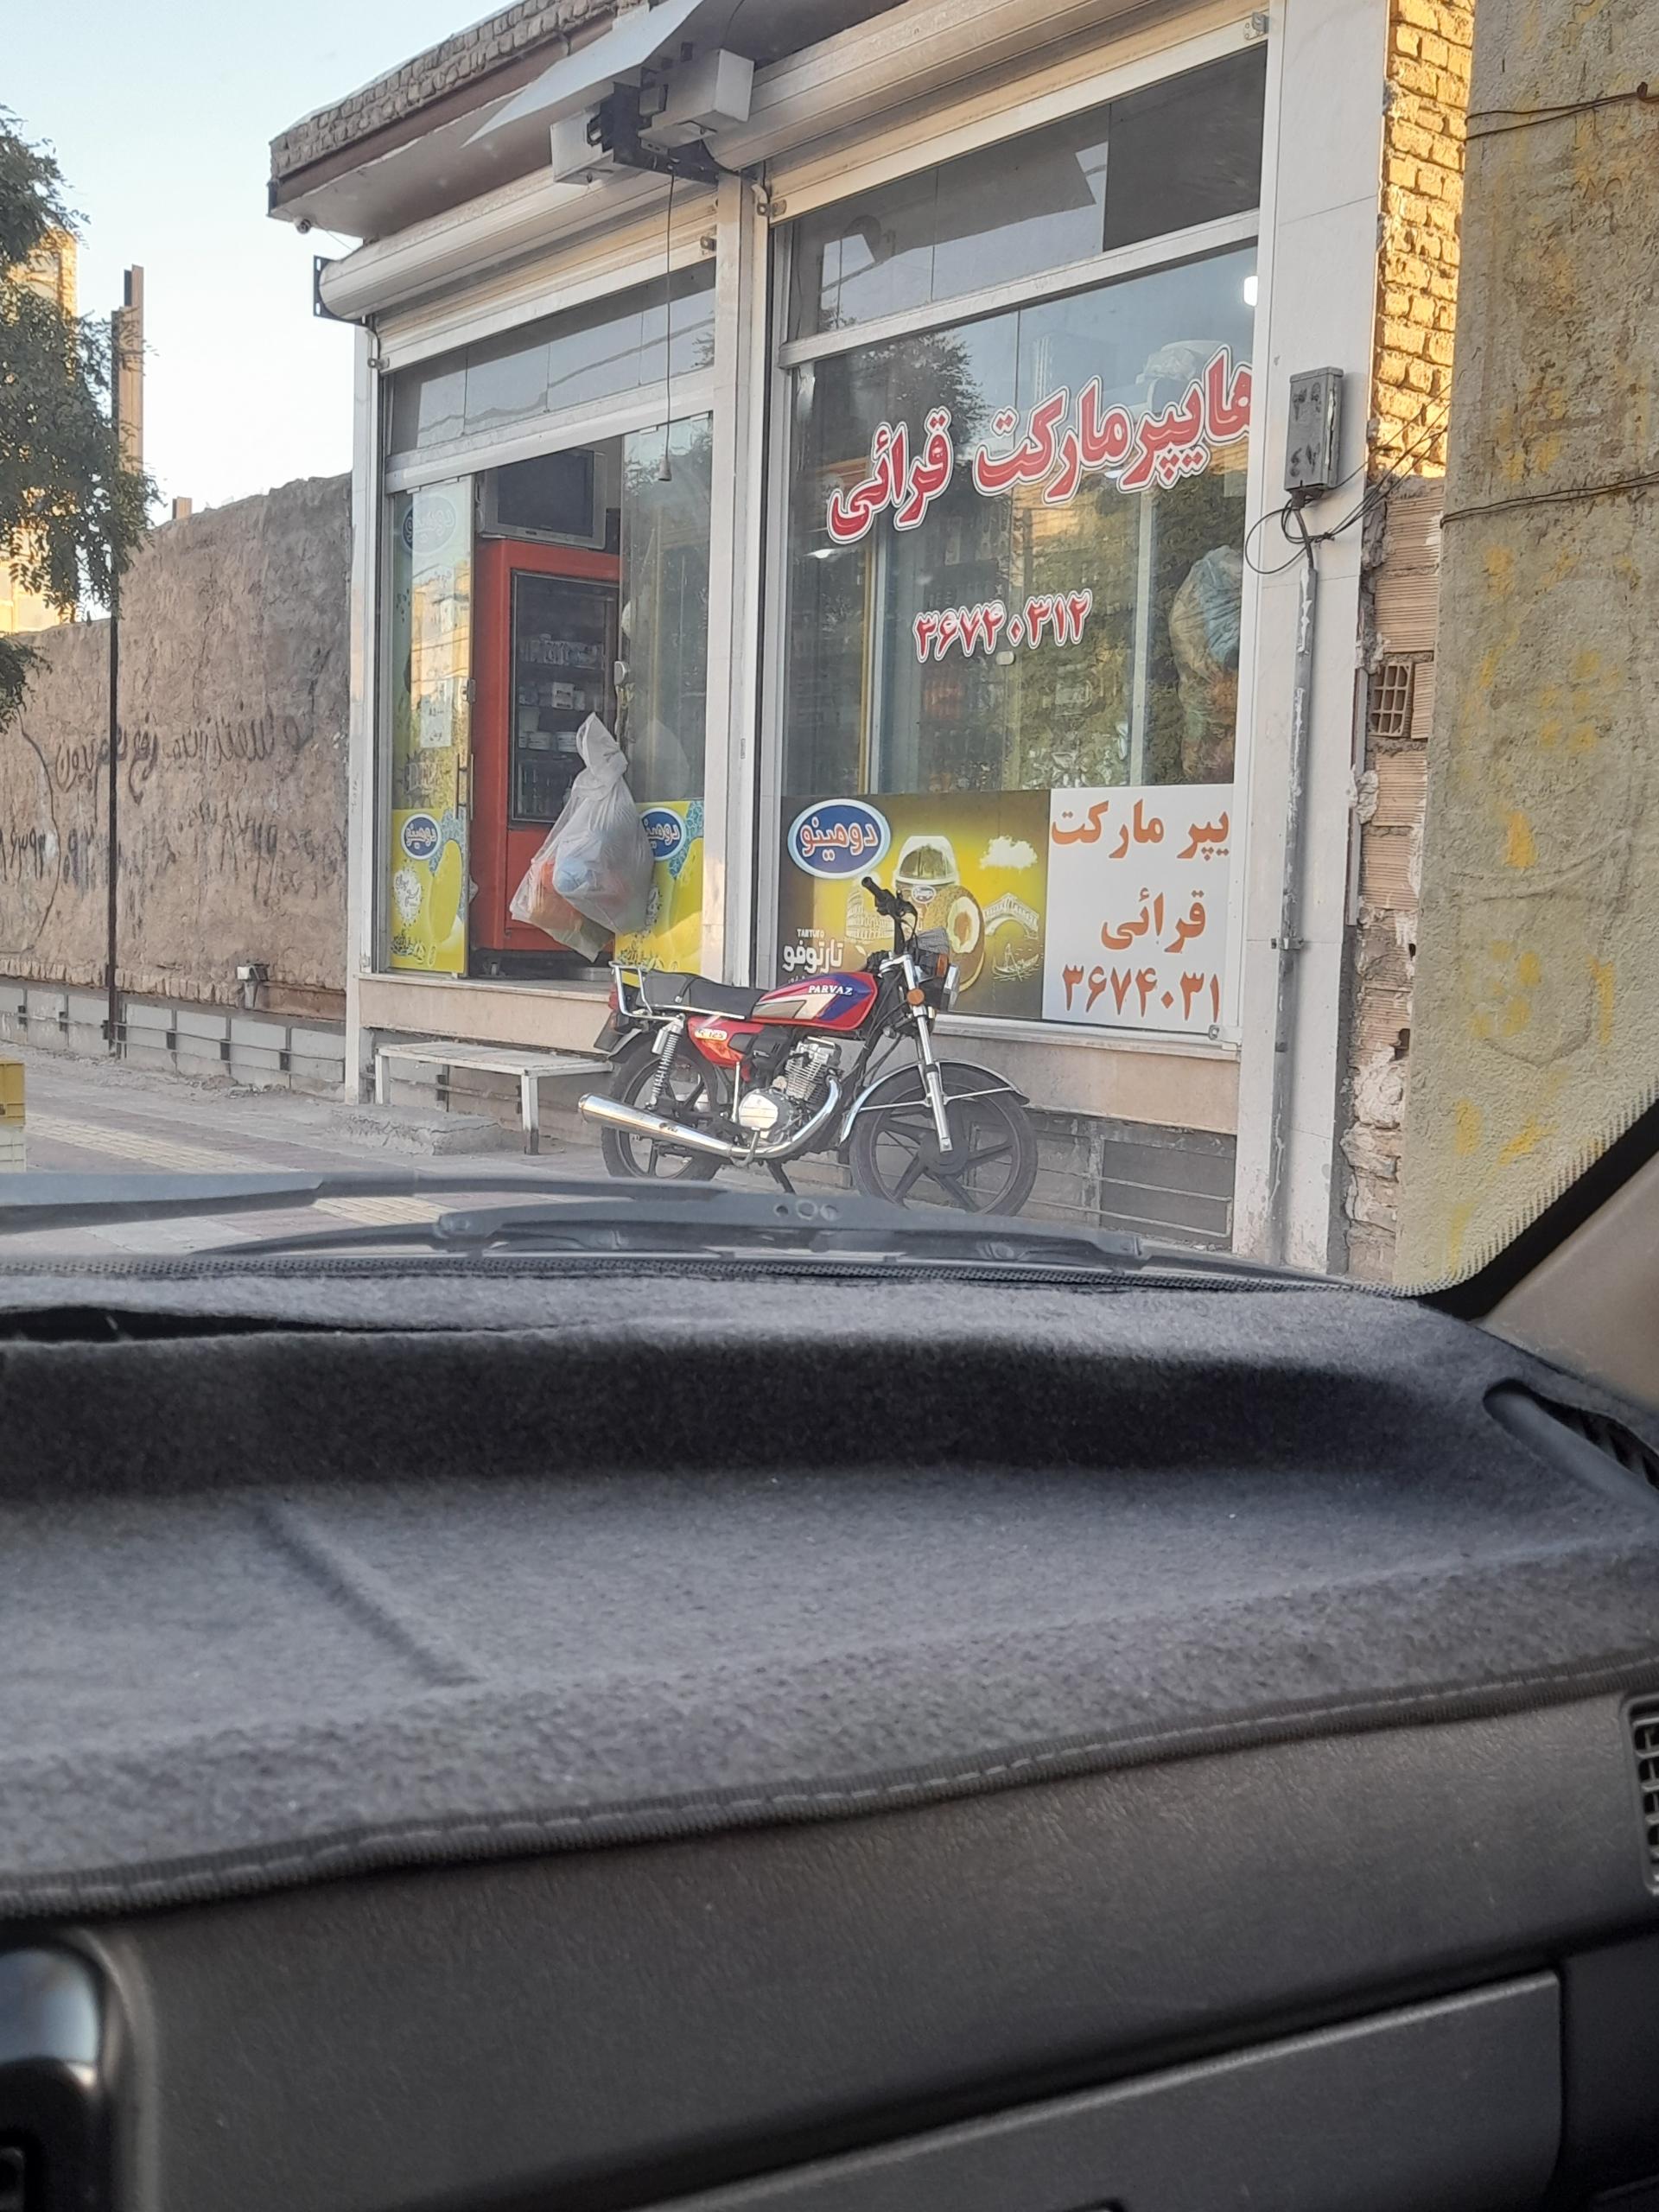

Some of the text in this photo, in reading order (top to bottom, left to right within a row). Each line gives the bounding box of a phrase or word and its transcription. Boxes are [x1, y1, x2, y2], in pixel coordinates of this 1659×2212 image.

[827, 405, 953, 544] قرائی
[912, 588, 1093, 663] ۳۶۷۴۰۳۱۲
[800, 816, 878, 861] دومینو
[1051, 798, 1164, 859] مارکت
[1101, 887, 1206, 953] قرائی
[781, 939, 844, 975] تارتوفو
[808, 984, 854, 996] PARVAZ
[1062, 963, 1220, 1024] ۳۶۷۴۰۳۱
